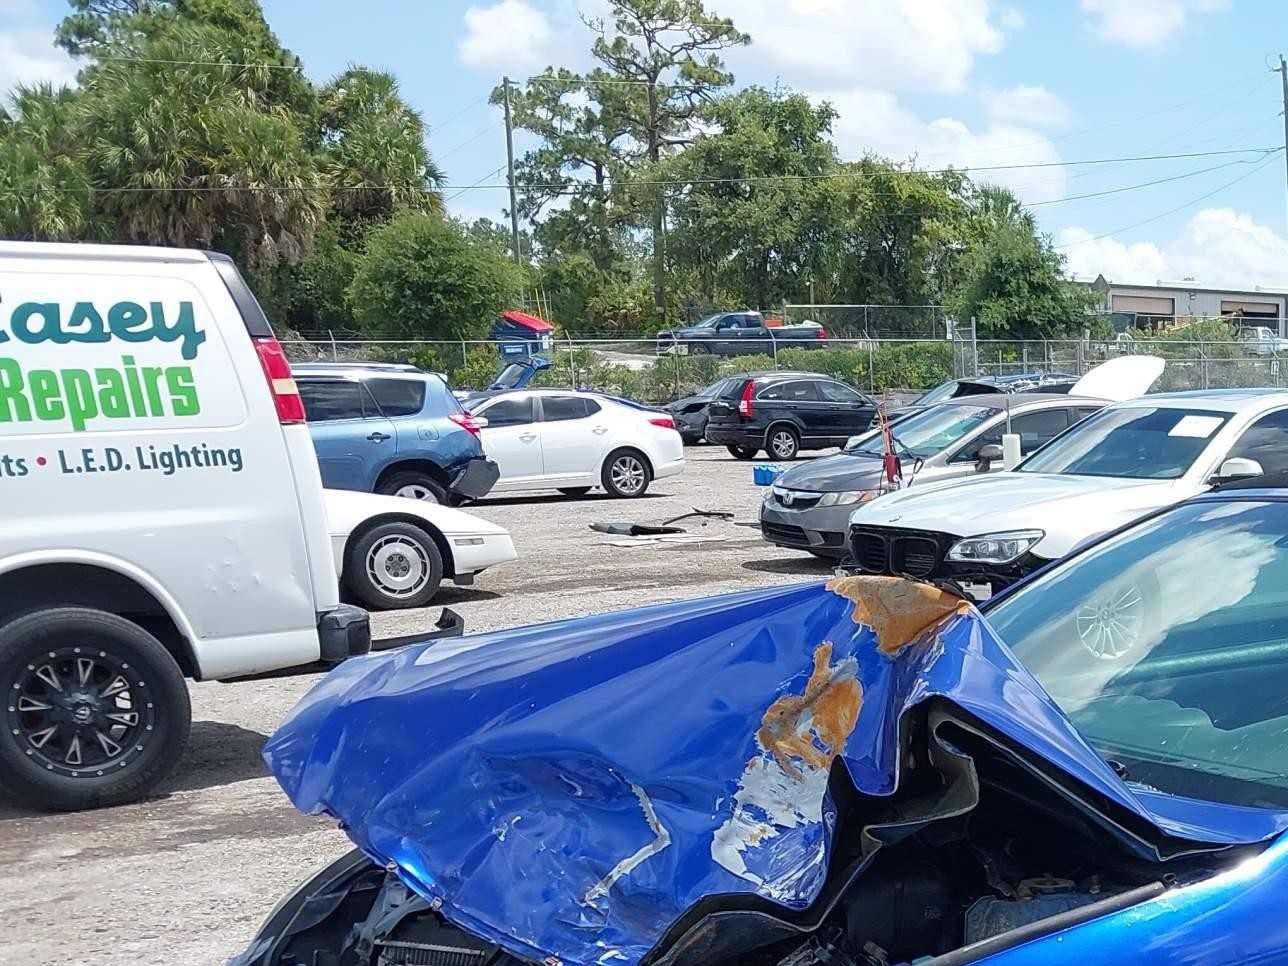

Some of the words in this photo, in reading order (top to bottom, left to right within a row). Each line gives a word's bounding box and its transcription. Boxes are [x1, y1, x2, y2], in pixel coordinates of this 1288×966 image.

[0, 293, 207, 360] asey
[0, 355, 201, 432] Repairs
[0, 454, 28, 477] ts
[58, 447, 131, 473] L.E.D.
[136, 443, 243, 475] Lighting
